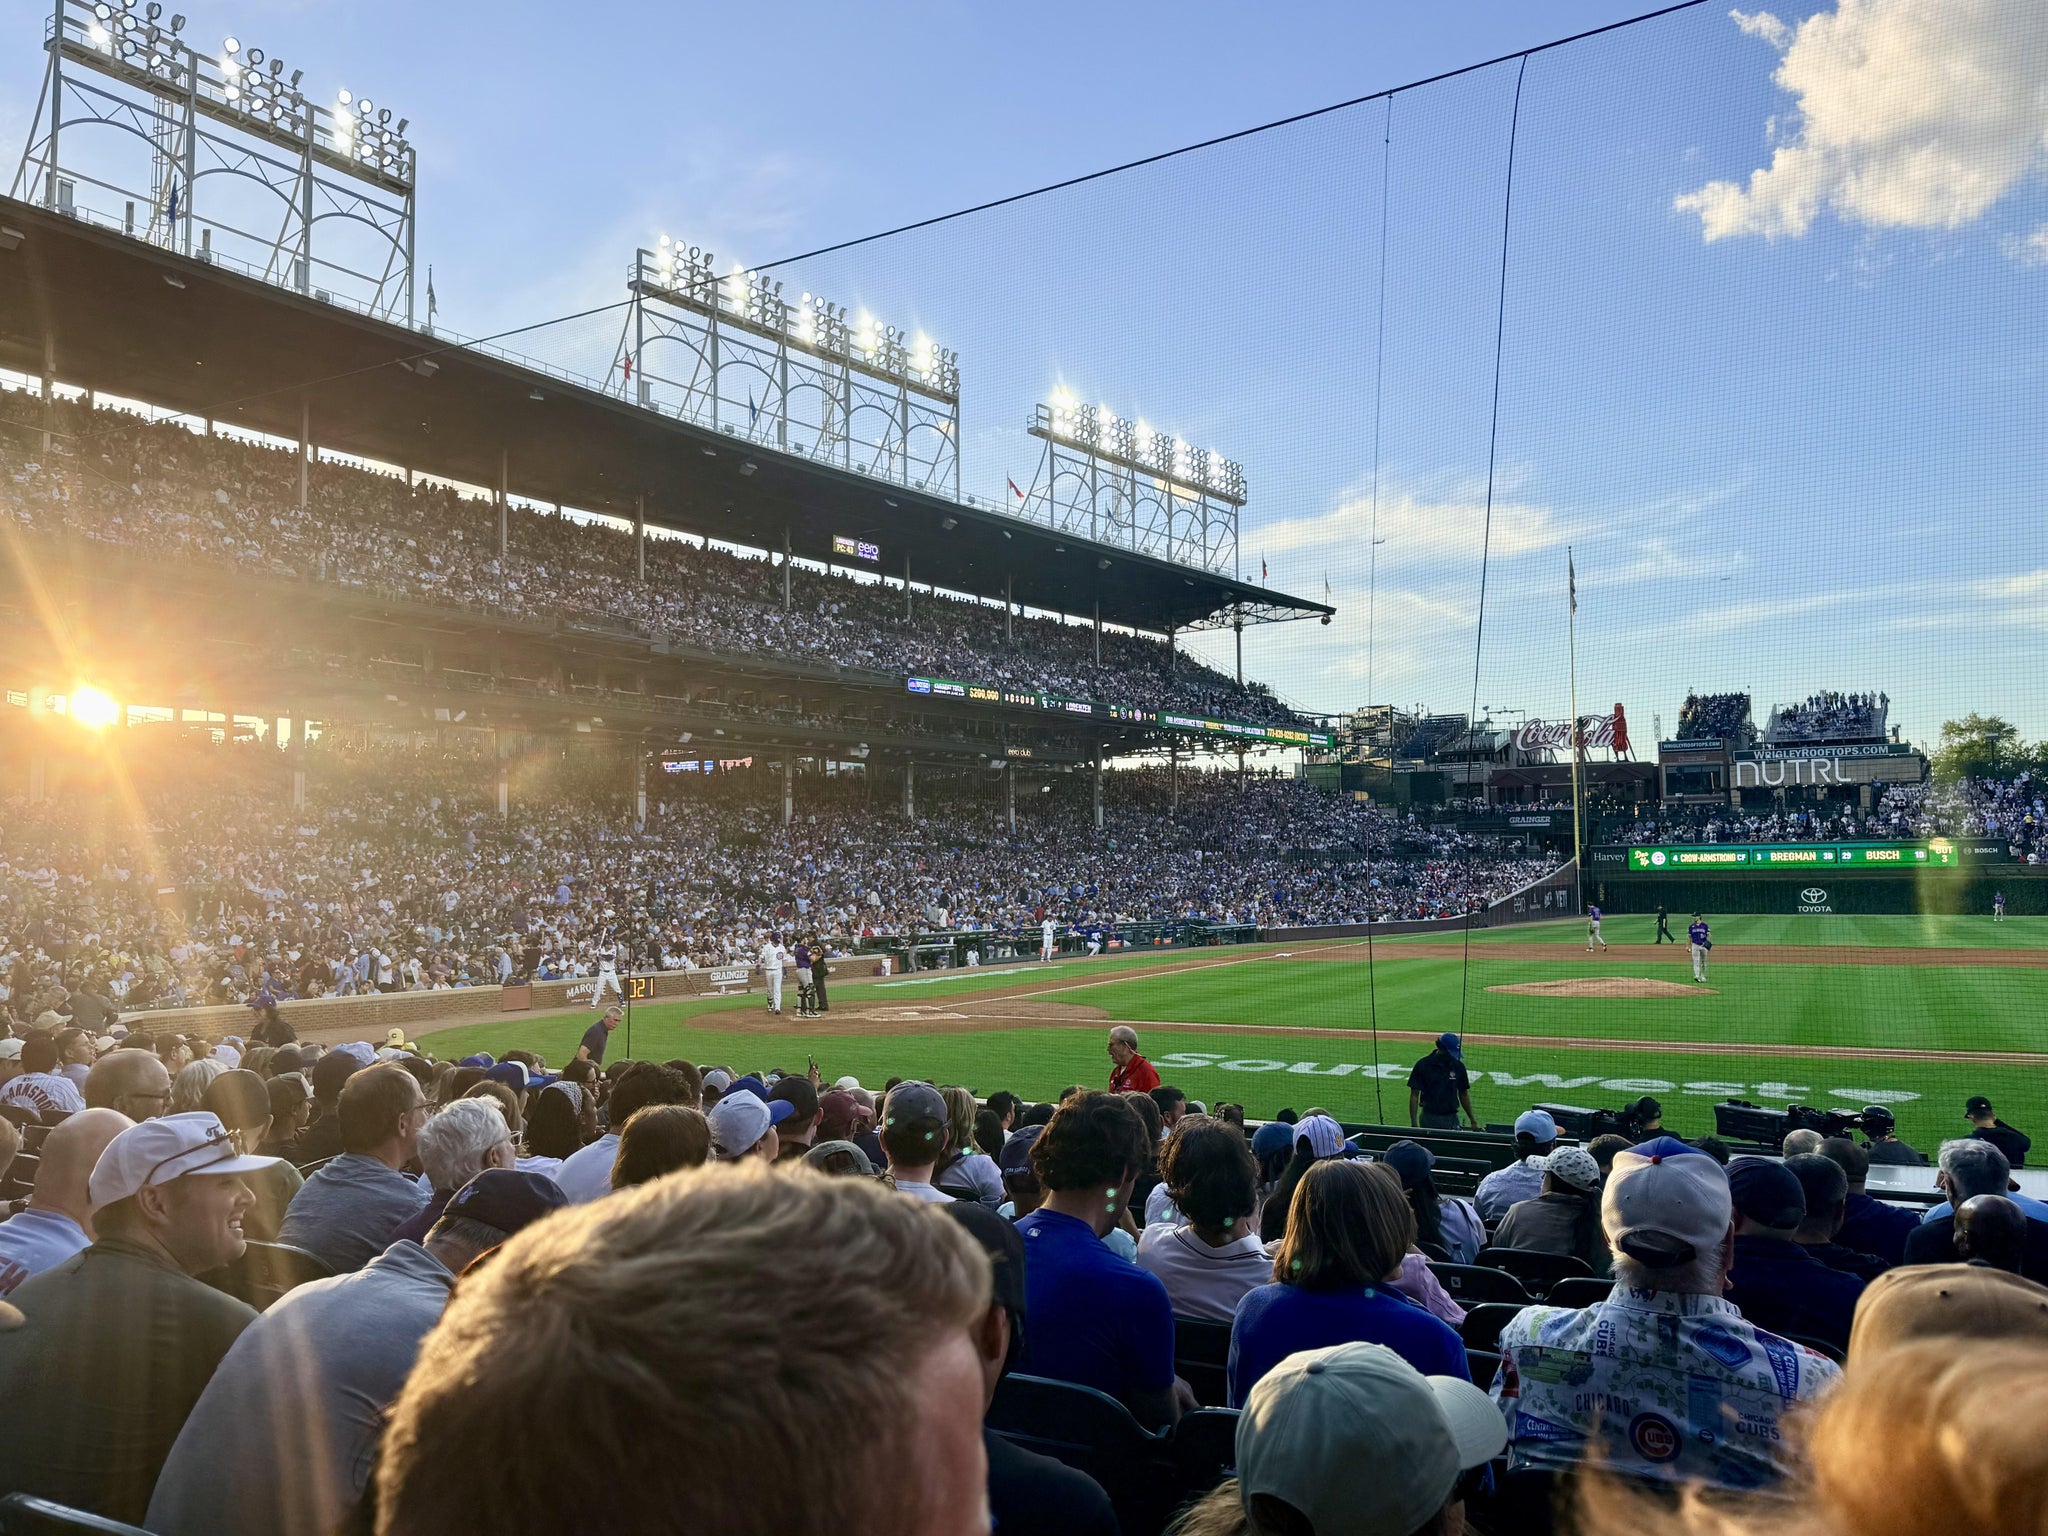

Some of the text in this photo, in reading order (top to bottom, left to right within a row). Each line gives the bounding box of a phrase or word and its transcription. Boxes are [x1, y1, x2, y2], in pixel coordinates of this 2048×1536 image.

[858, 542, 879, 555] eero
[1754, 746, 1889, 760] WRIGLEYROOFTOPS.COM
[1509, 816, 1551, 824] GRAINGER
[1593, 852, 1626, 863] Harvey
[1680, 853, 1736, 863] CROW-ARMSTRONG
[1737, 853, 1746, 862] CF
[1770, 851, 1817, 861] BREGMAN
[1842, 852, 1852, 860] 29
[1866, 850, 1900, 860] BUSCH
[1941, 854, 1948, 863] 3
[710, 970, 749, 981] GRAINGER
[566, 982, 607, 999] MARQUE
[1150, 1052, 1811, 1100] Soutwest
[1576, 1392, 1630, 1417] CHICAGO
[1735, 1421, 1780, 1440] CUBS
